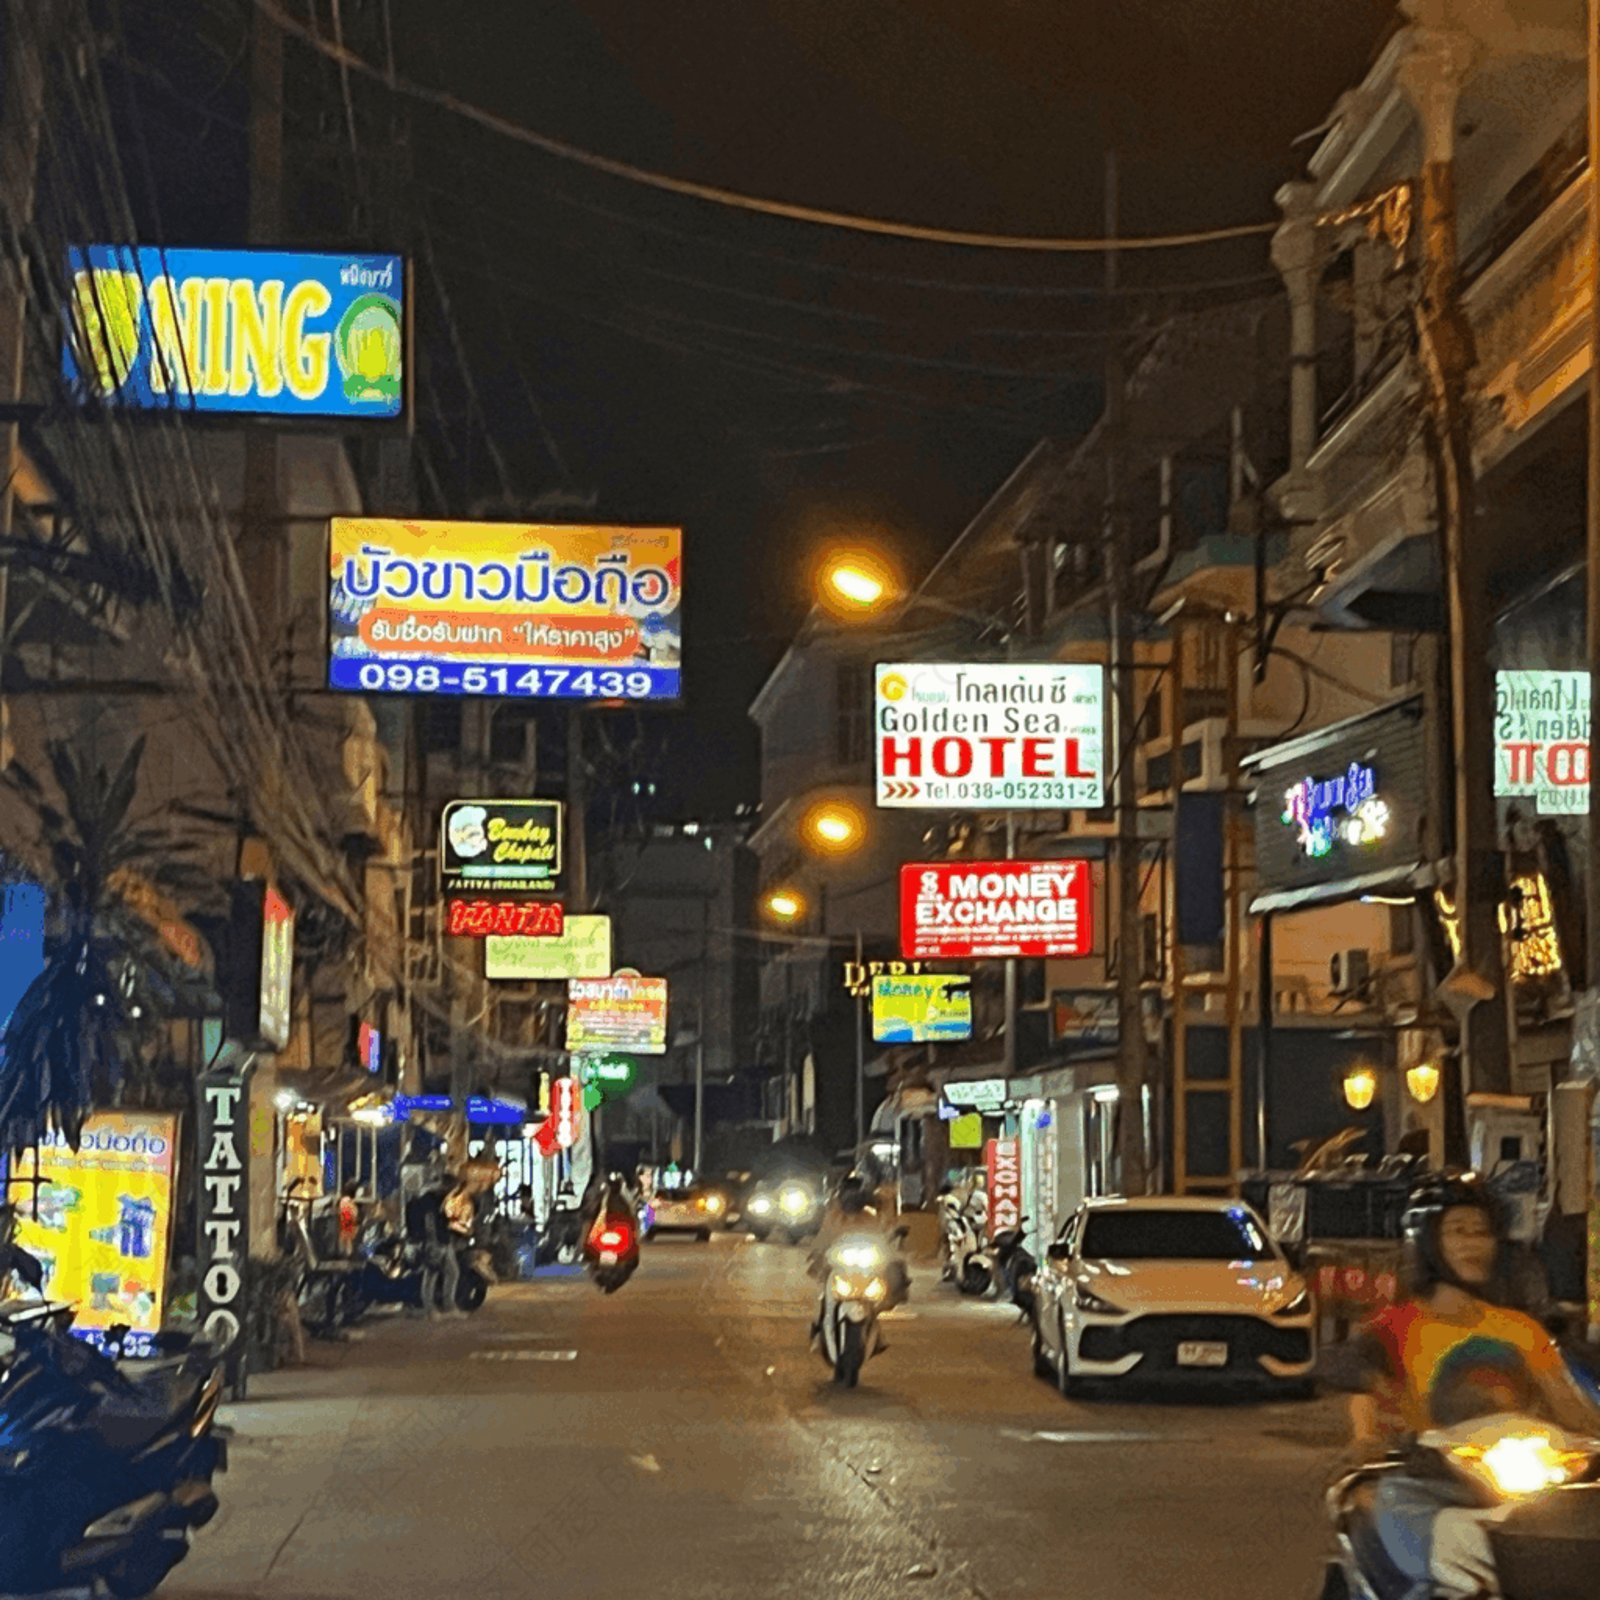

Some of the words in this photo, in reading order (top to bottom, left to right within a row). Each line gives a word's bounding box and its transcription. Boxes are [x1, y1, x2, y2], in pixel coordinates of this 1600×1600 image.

[345, 545, 669, 606] บัวขาวมือถือ
[359, 663, 652, 697] 098-5147439
[880, 706, 988, 733] Golden
[1003, 707, 1060, 734] Sea
[882, 736, 1097, 779] HOTEL
[925, 782, 1098, 800] Tel.038-052331-2
[949, 872, 1076, 899] MONEY
[915, 898, 1078, 925] EXCHANGE
[204, 1088, 242, 1346] TATTOO
